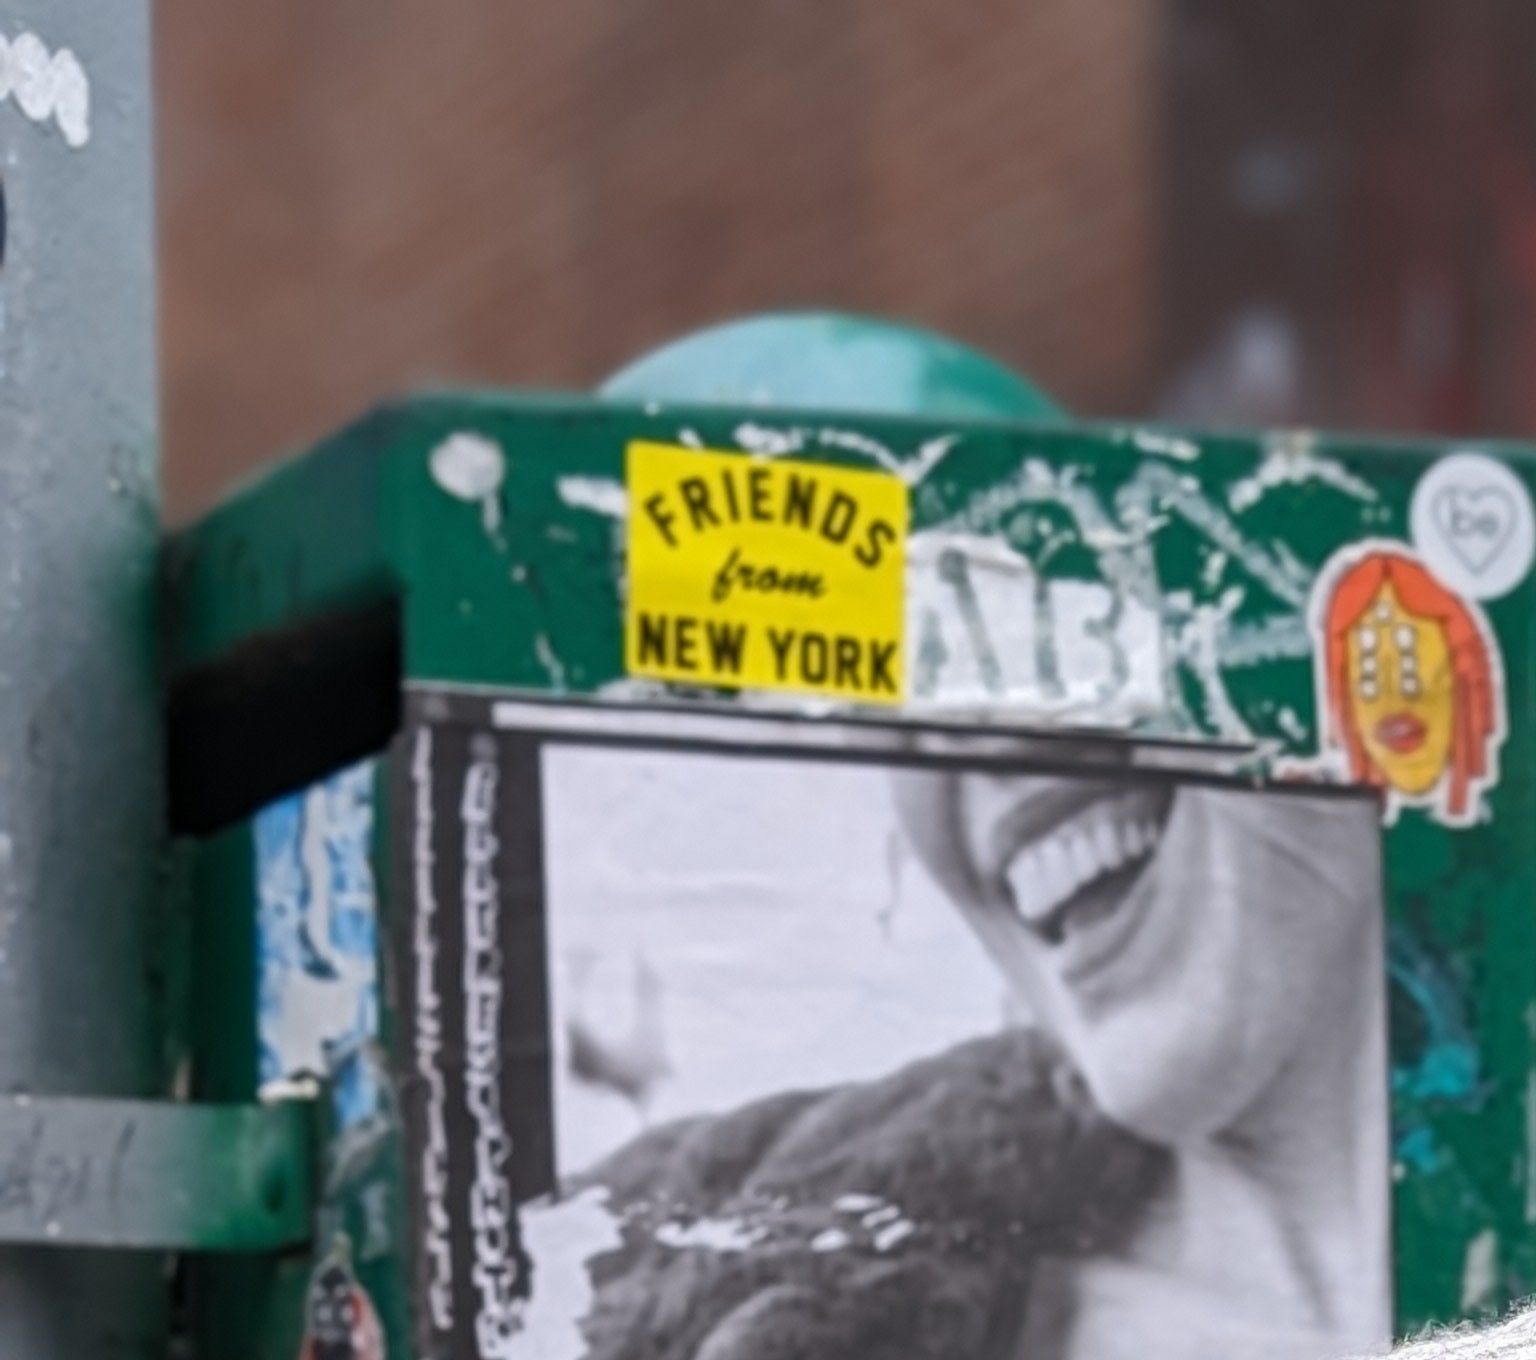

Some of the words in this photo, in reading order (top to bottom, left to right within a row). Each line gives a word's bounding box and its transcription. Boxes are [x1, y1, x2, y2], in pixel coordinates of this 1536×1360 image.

[643, 468, 896, 569] FRIENDS
[711, 547, 825, 602] from
[637, 611, 746, 674] NEW
[766, 626, 897, 694] YORK
